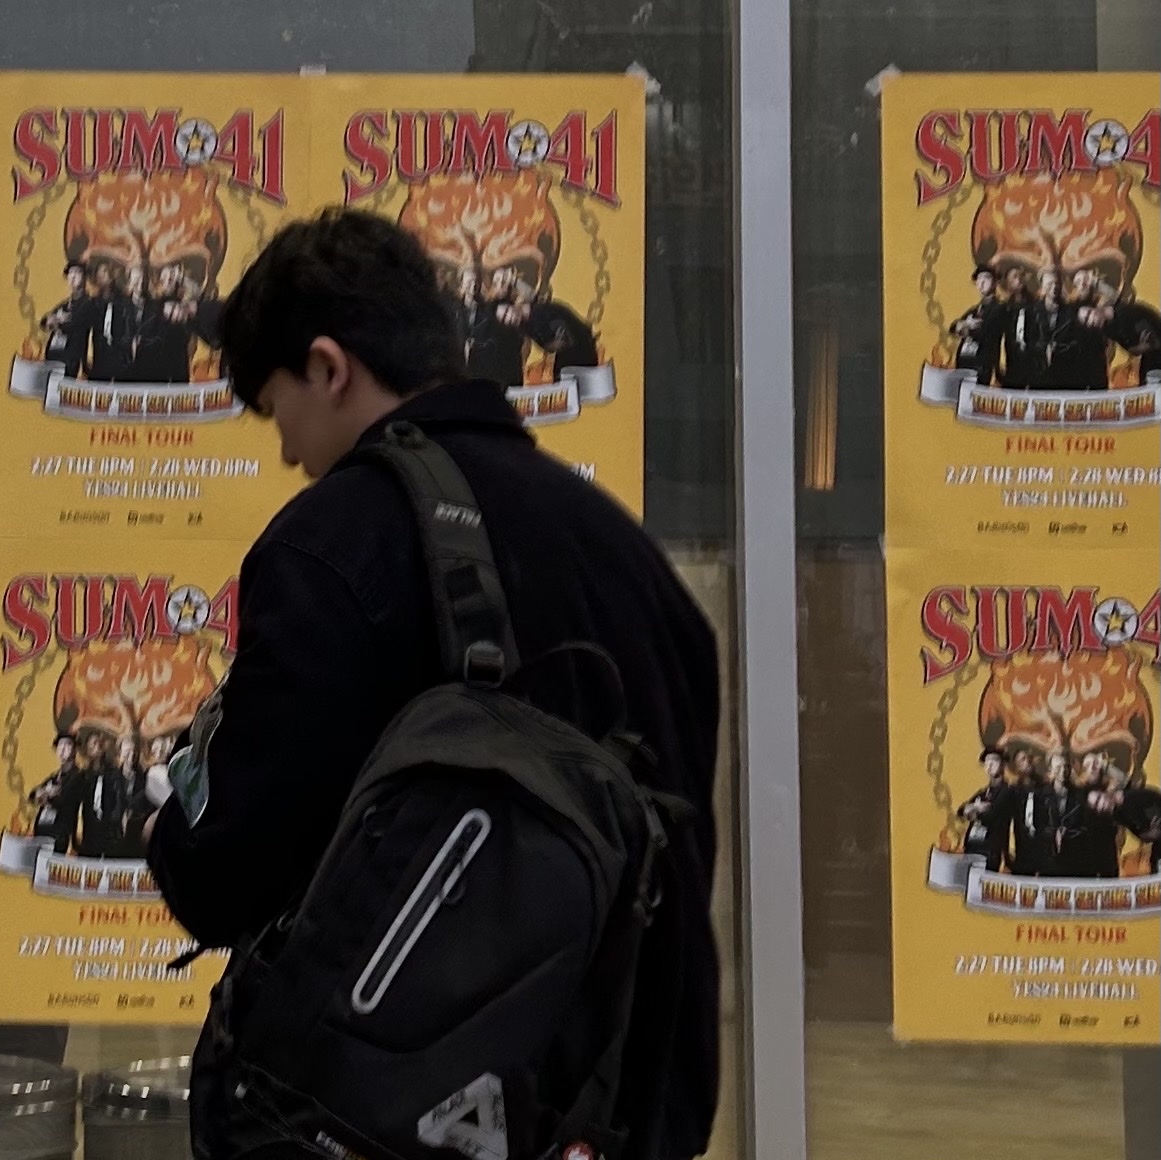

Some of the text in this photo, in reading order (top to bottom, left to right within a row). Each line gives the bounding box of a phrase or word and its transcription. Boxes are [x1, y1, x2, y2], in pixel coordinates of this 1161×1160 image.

[12, 106, 287, 207] SUM 41
[344, 108, 621, 209] SUM 41
[915, 108, 1161, 208] SUM 4
[90, 427, 194, 447] FINAL TOUR
[1005, 435, 1116, 455] FINAL TOUR
[1106, 467, 1145, 486] WED
[1, 571, 240, 674] SUM 4
[921, 584, 1107, 688] SUM
[79, 904, 174, 926] FINAL TOU
[1016, 923, 1127, 944] FINAL TOUR
